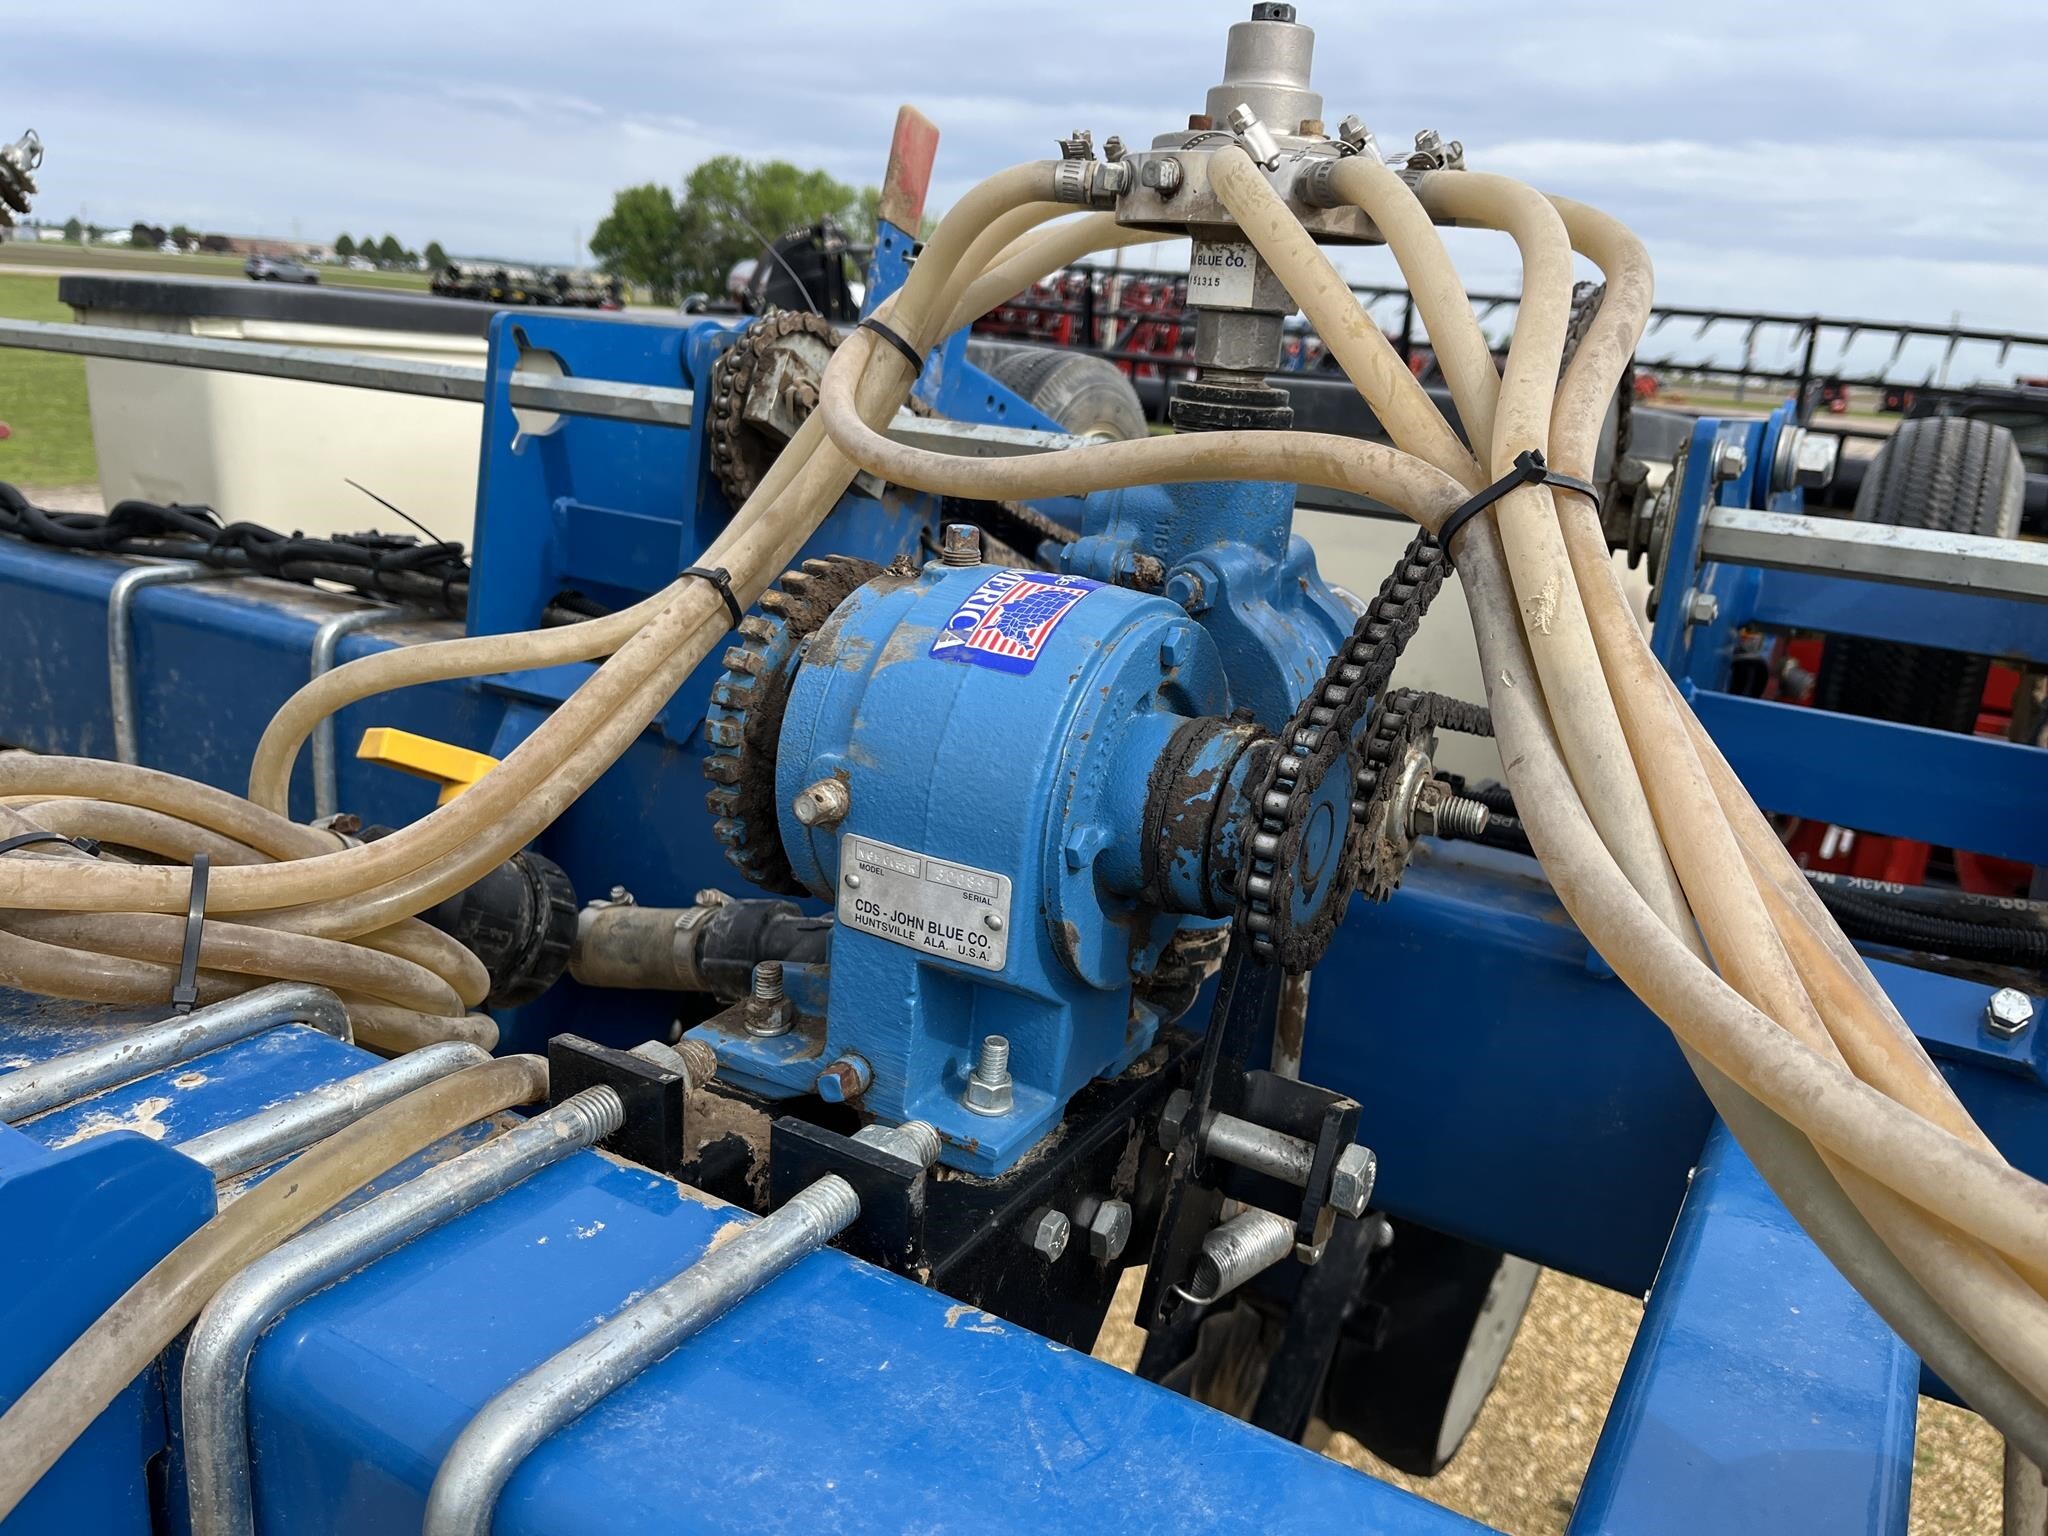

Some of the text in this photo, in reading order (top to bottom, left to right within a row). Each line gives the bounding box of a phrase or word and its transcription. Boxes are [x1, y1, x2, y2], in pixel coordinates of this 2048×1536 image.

[1197, 255, 1222, 266] BLUE
[1225, 256, 1247, 267] CO.
[859, 862, 884, 876] MODEL
[962, 892, 993, 906] SERIAL
[855, 898, 880, 917] CDS
[890, 909, 924, 932] JOHN
[928, 920, 963, 942] BLUE
[967, 932, 992, 949] CO.
[855, 913, 990, 962] HUNTSVILLE ALA. U.S.A.
